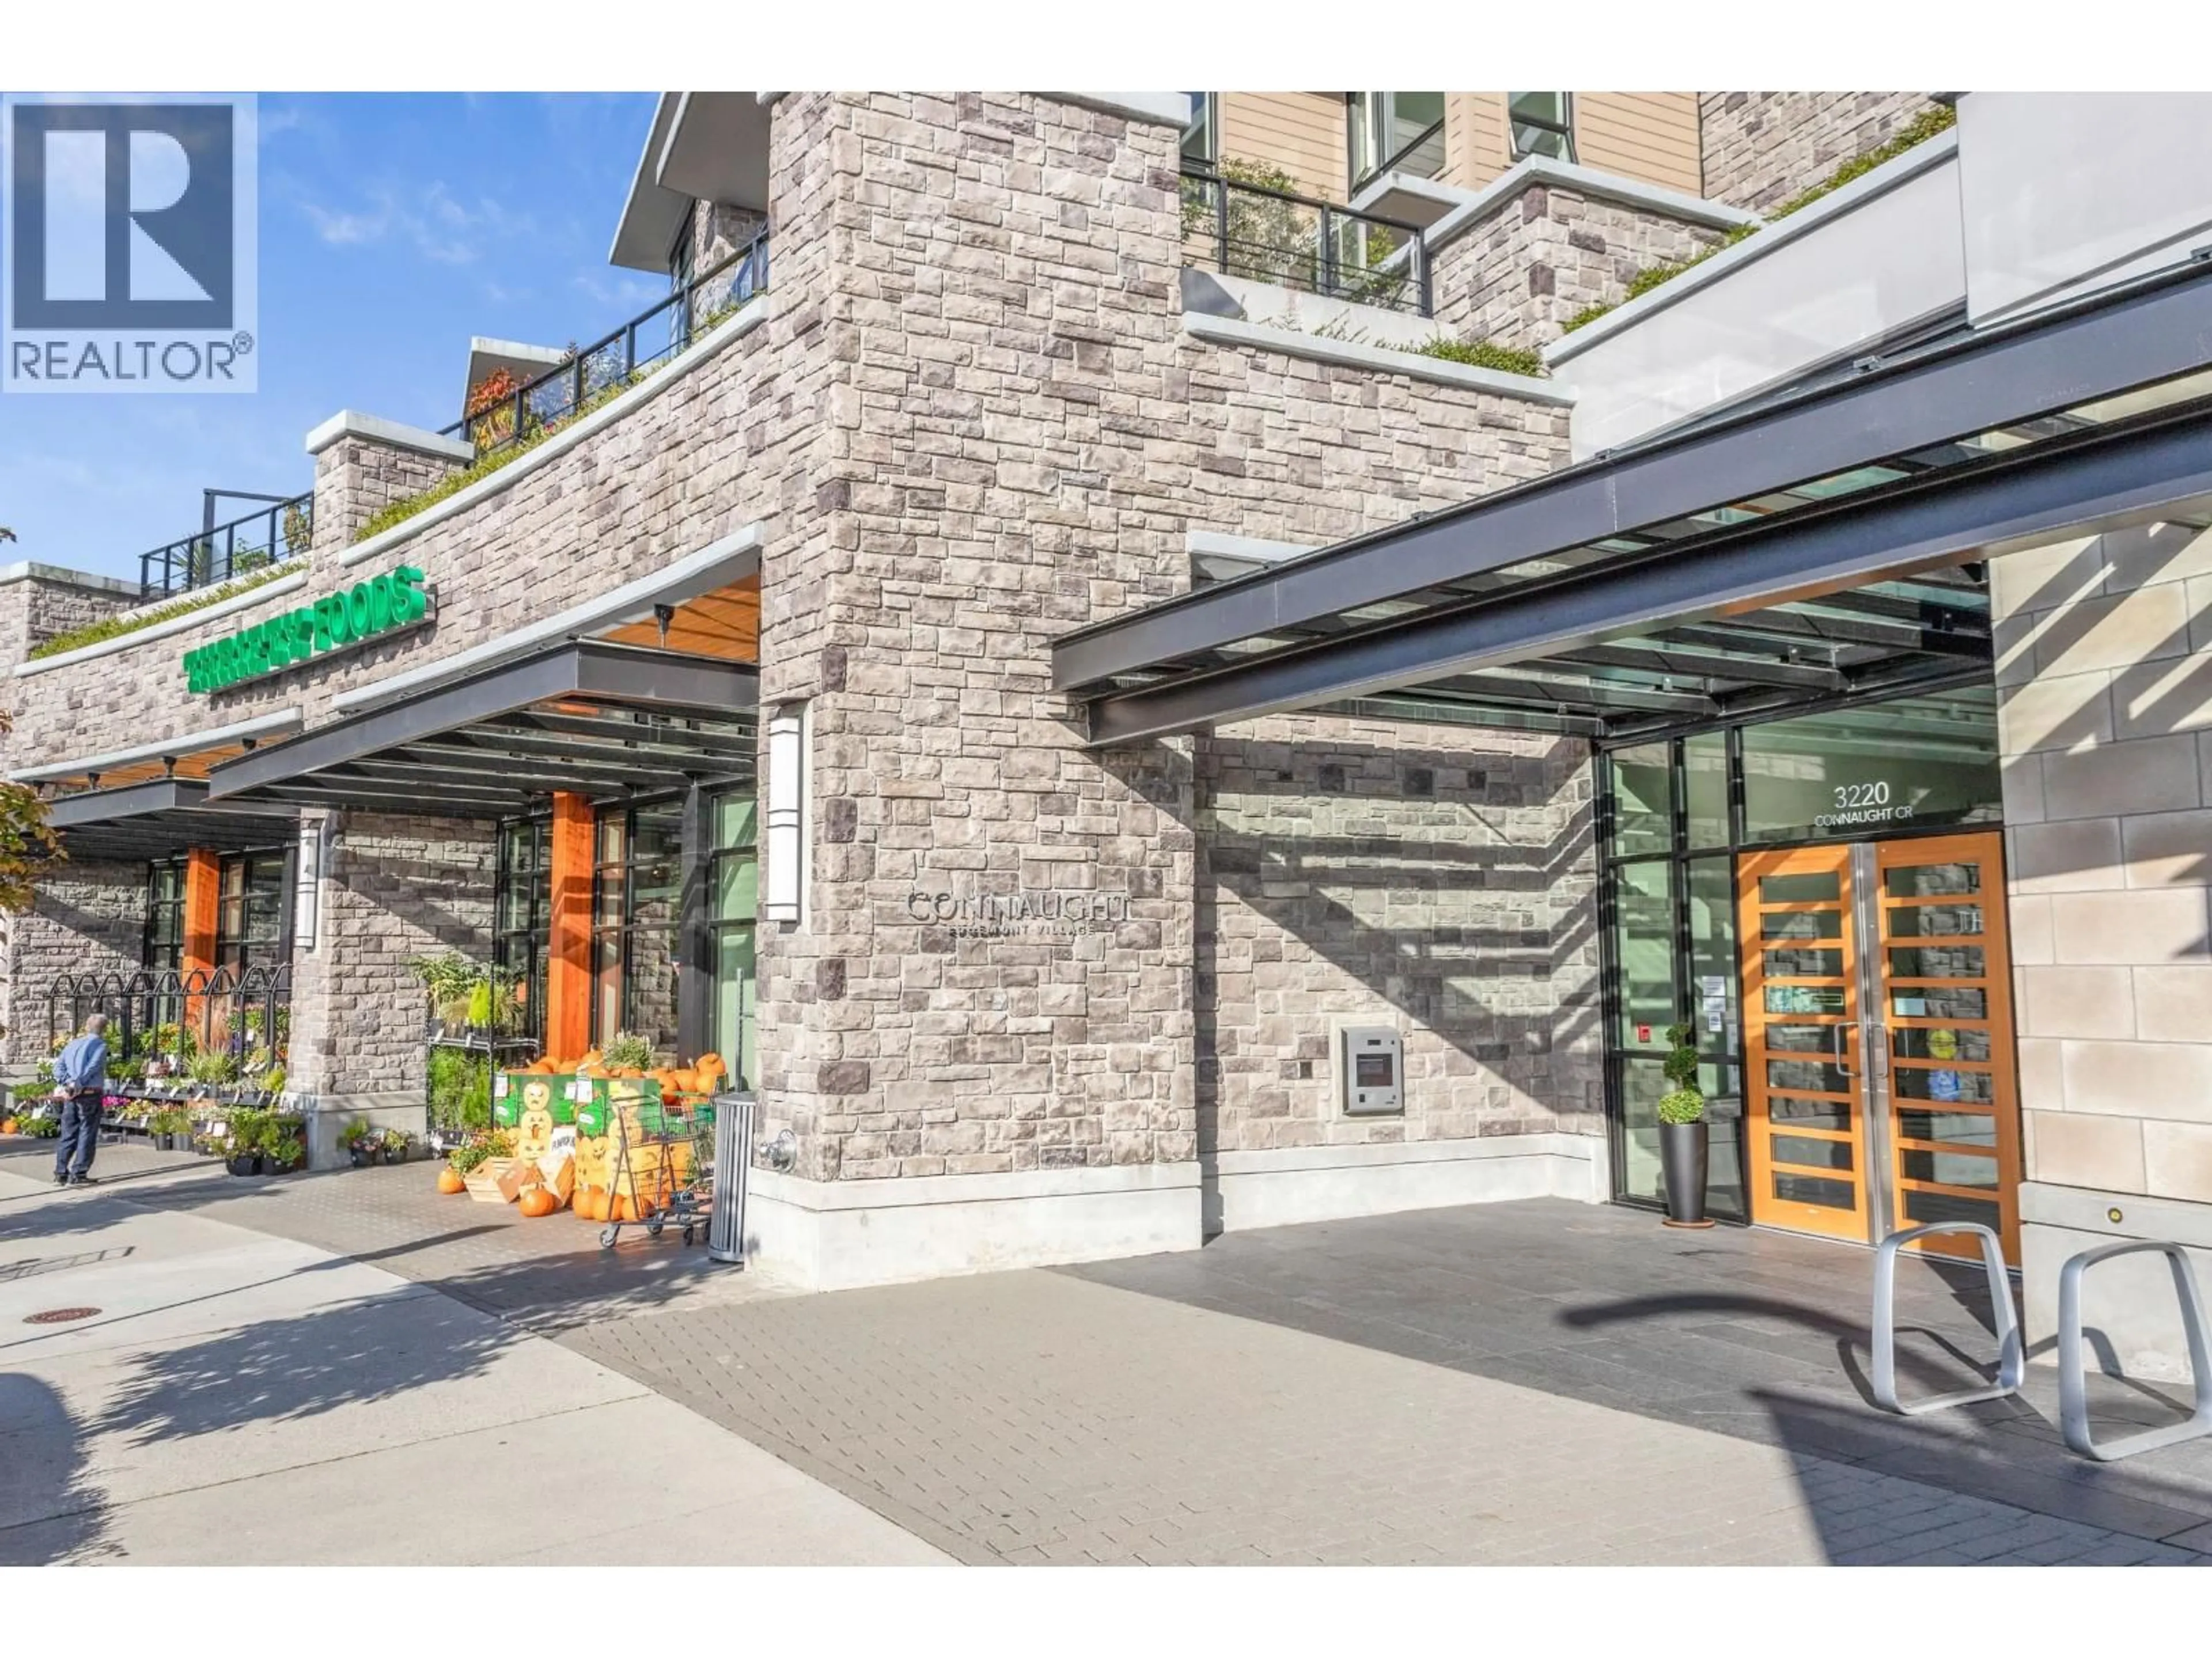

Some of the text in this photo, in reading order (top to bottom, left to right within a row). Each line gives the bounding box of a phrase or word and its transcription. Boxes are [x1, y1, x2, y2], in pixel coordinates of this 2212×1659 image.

[313, 564, 425, 652] FOODS
[1834, 781, 1889, 809] 3220
[1815, 805, 1914, 827] CONNAUGHT CR
[908, 892, 1134, 922] CONNAUGHT
